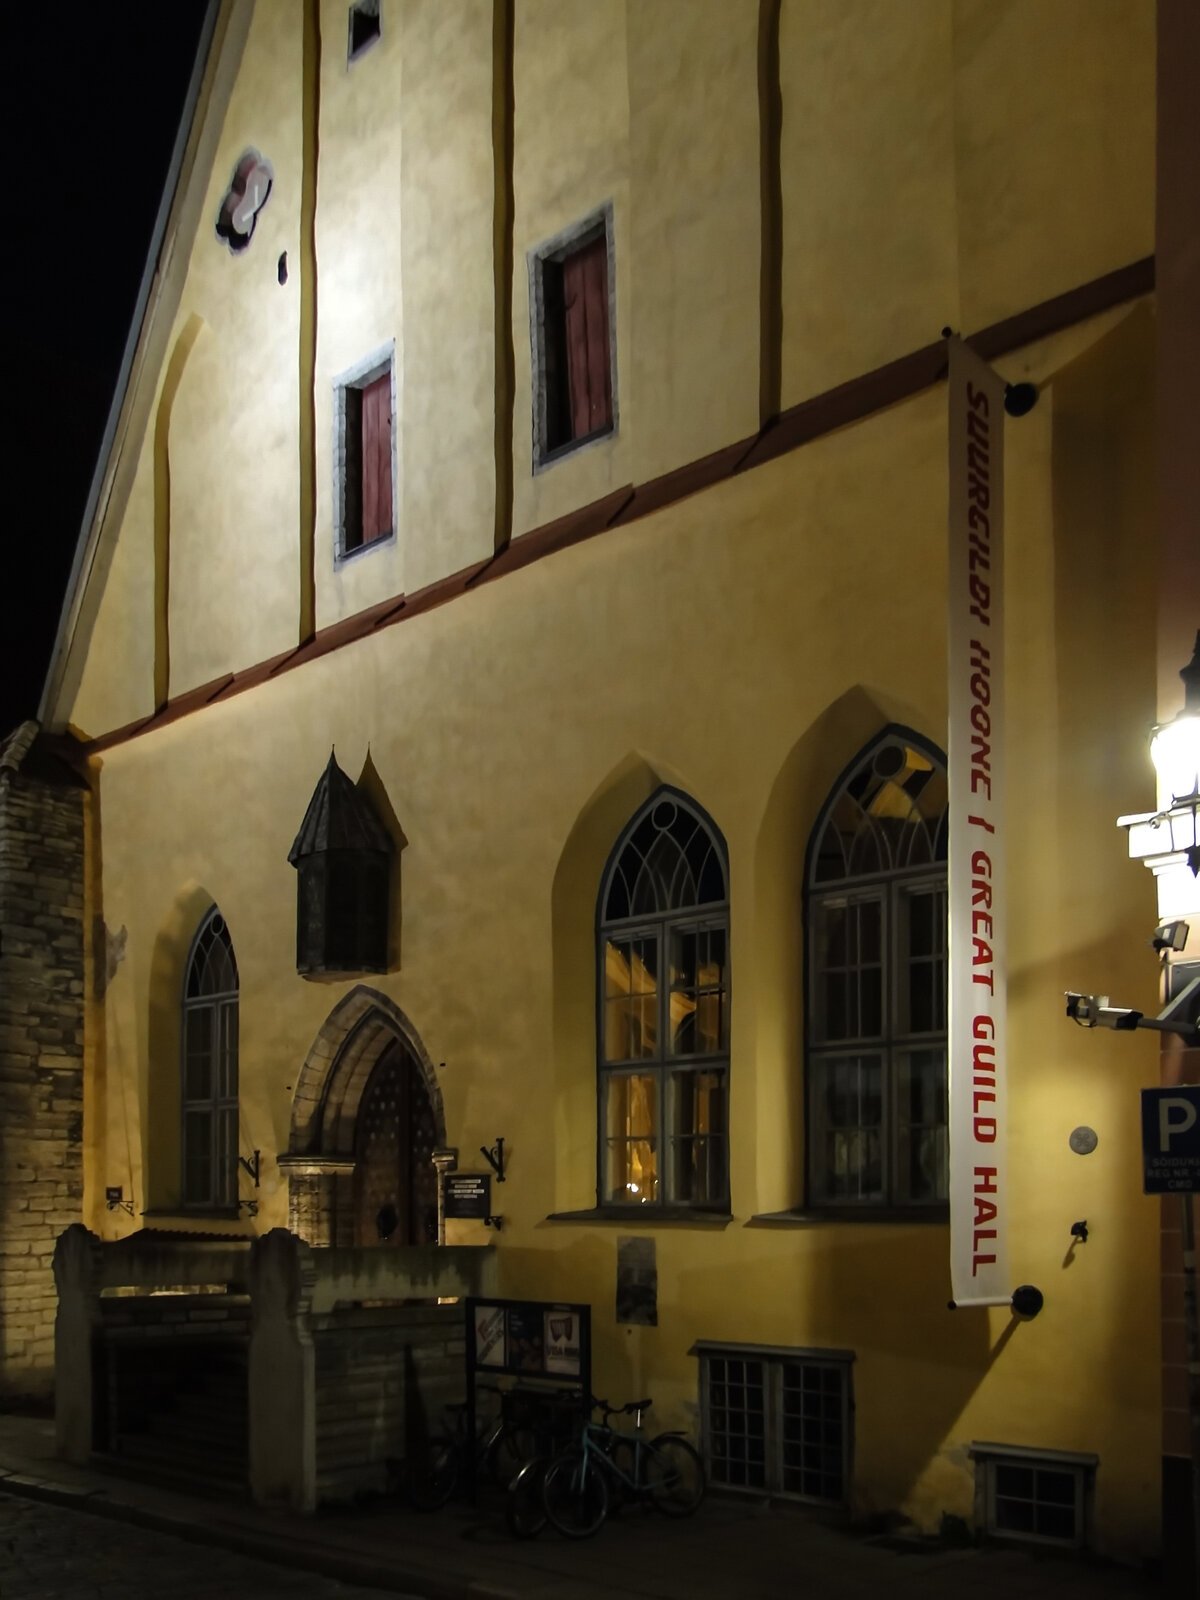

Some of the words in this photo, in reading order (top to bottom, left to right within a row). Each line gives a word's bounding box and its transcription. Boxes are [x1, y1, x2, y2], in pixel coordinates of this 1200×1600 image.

[966, 382, 990, 627] SUURGILDI
[970, 640, 992, 802] HOONE
[971, 850, 994, 997] GREAT
[972, 1015, 998, 1144] GUILD
[1158, 1097, 1197, 1153] P
[972, 1166, 998, 1278] HALL
